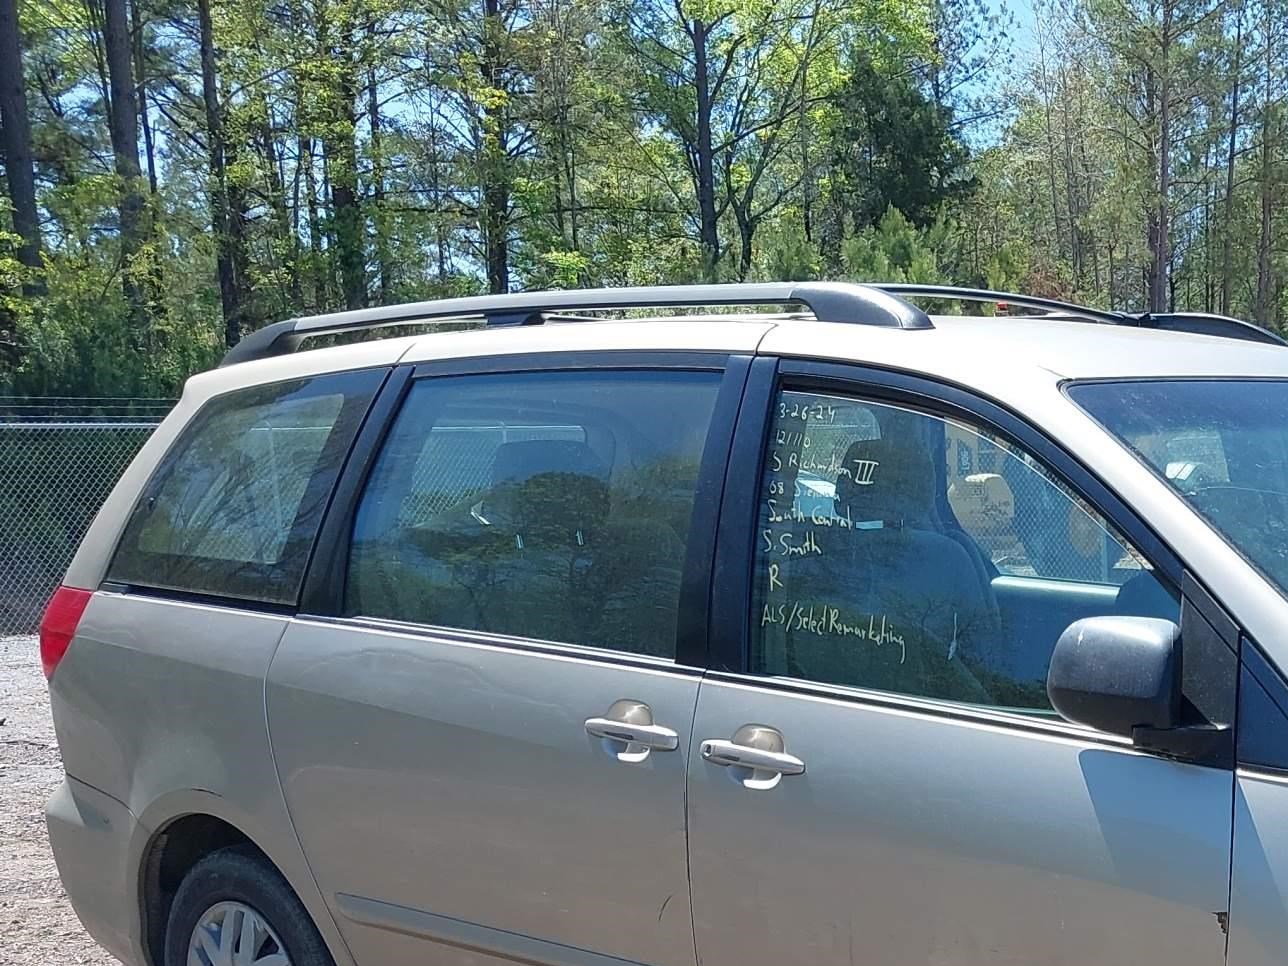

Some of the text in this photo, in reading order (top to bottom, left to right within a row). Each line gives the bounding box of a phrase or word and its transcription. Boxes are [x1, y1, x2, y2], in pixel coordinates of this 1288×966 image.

[779, 402, 836, 423] 3-26-24
[769, 479, 785, 495] 08
[767, 499, 805, 523] South
[768, 564, 784, 592] R
